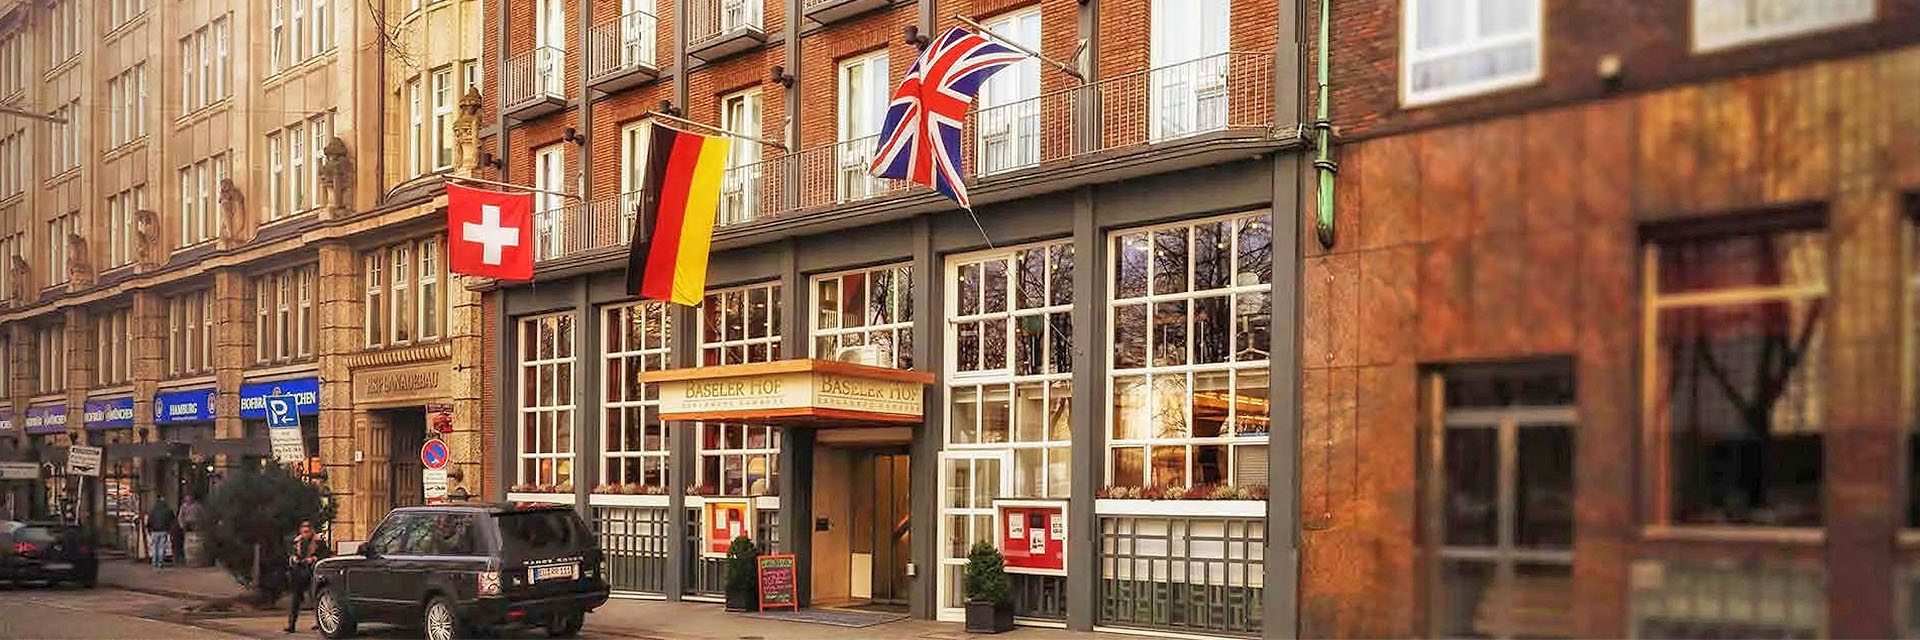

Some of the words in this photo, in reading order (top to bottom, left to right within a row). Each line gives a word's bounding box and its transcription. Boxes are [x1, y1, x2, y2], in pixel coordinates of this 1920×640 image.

[685, 380, 745, 398] BASELER
[750, 379, 783, 395] HOF
[820, 377, 883, 398] BASELER
[889, 381, 919, 401] HOF
[169, 402, 198, 416] HAMBURG
[241, 396, 266, 411] HOFBR
[270, 400, 288, 424] P
